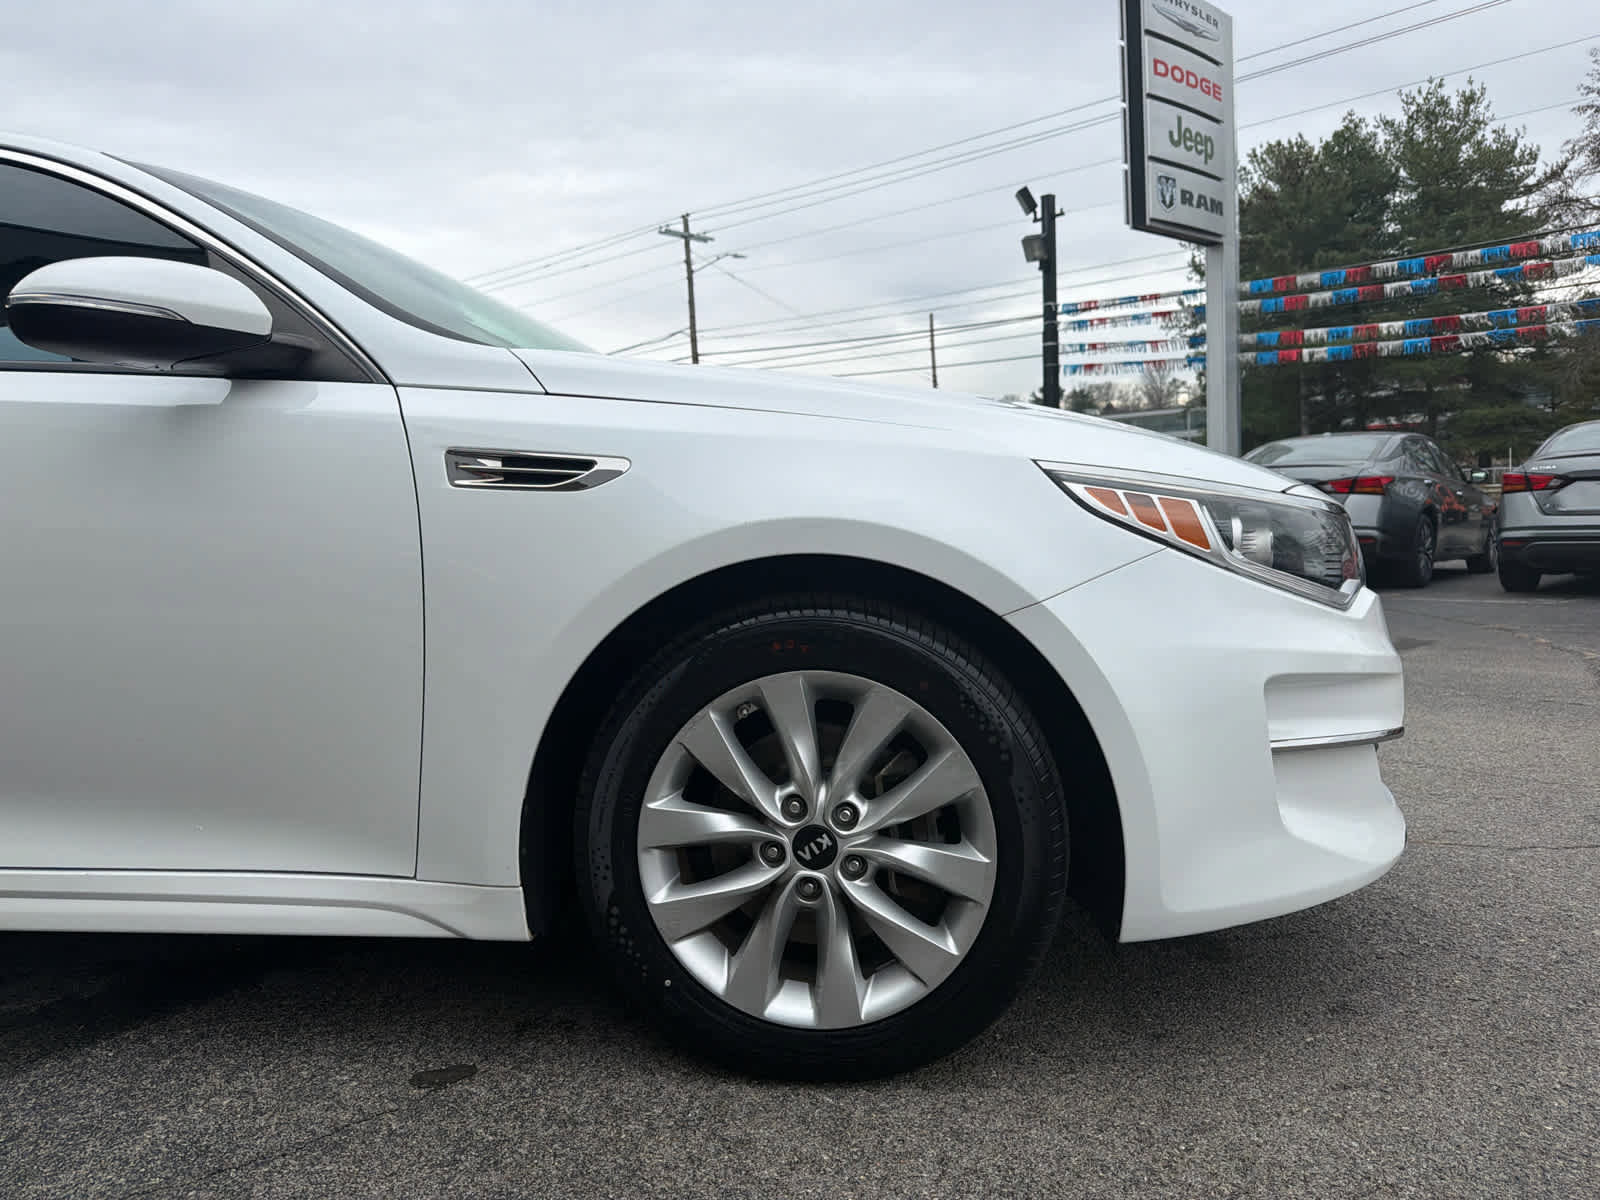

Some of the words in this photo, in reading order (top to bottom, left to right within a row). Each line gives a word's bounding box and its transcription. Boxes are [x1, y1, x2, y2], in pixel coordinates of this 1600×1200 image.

[1163, 0, 1218, 29] HRYSLER
[1153, 58, 1222, 102] DODGE
[1168, 115, 1214, 165] Jeep
[1180, 189, 1224, 216] RAM
[797, 832, 833, 861] KIA
